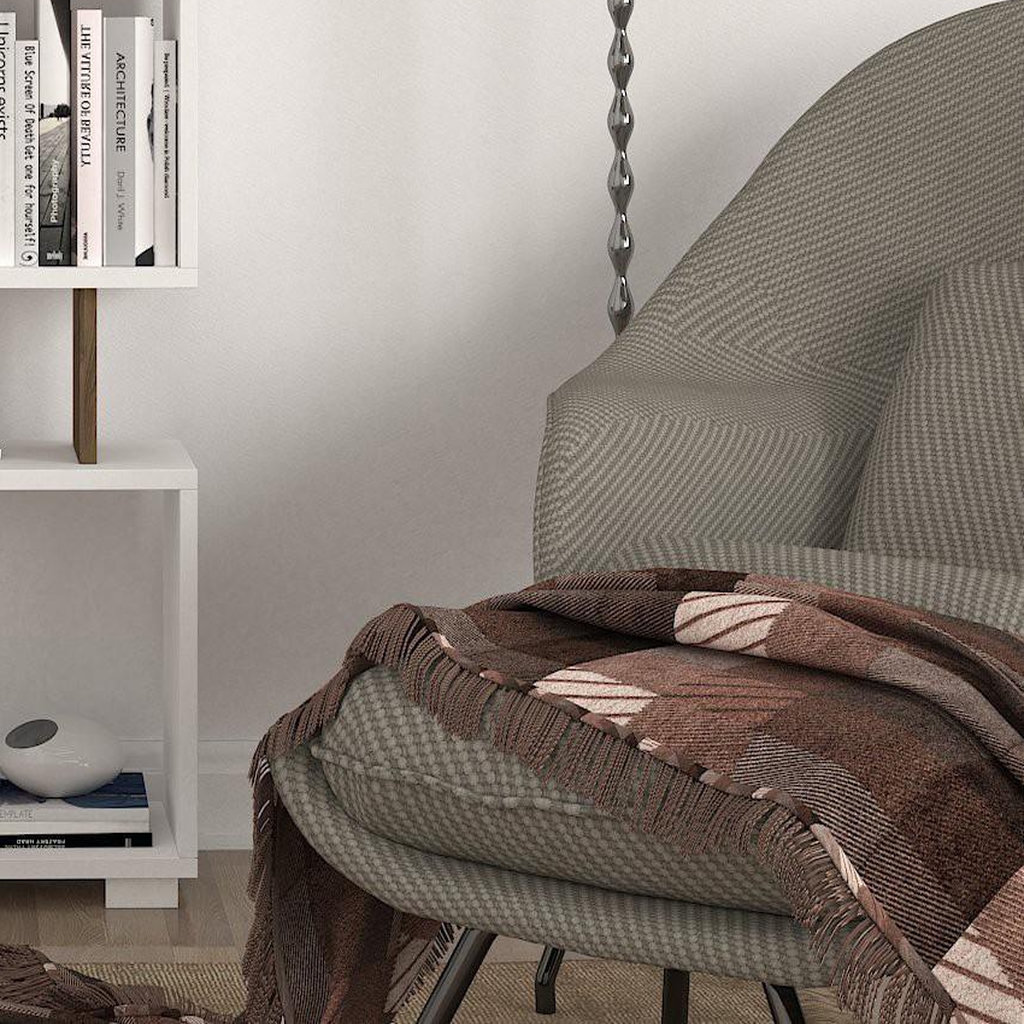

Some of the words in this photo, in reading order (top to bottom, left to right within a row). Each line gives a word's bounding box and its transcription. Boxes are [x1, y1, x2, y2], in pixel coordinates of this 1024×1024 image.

[24, 45, 36, 66] Blue
[24, 70, 36, 100] Screen
[24, 104, 36, 114] Of
[116, 52, 126, 152] ARCHITECTURE
[24, 118, 36, 144] Death
[24, 145, 36, 160] Get
[24, 164, 34, 180] one
[24, 185, 36, 198] for
[50, 159, 60, 223] Photography
